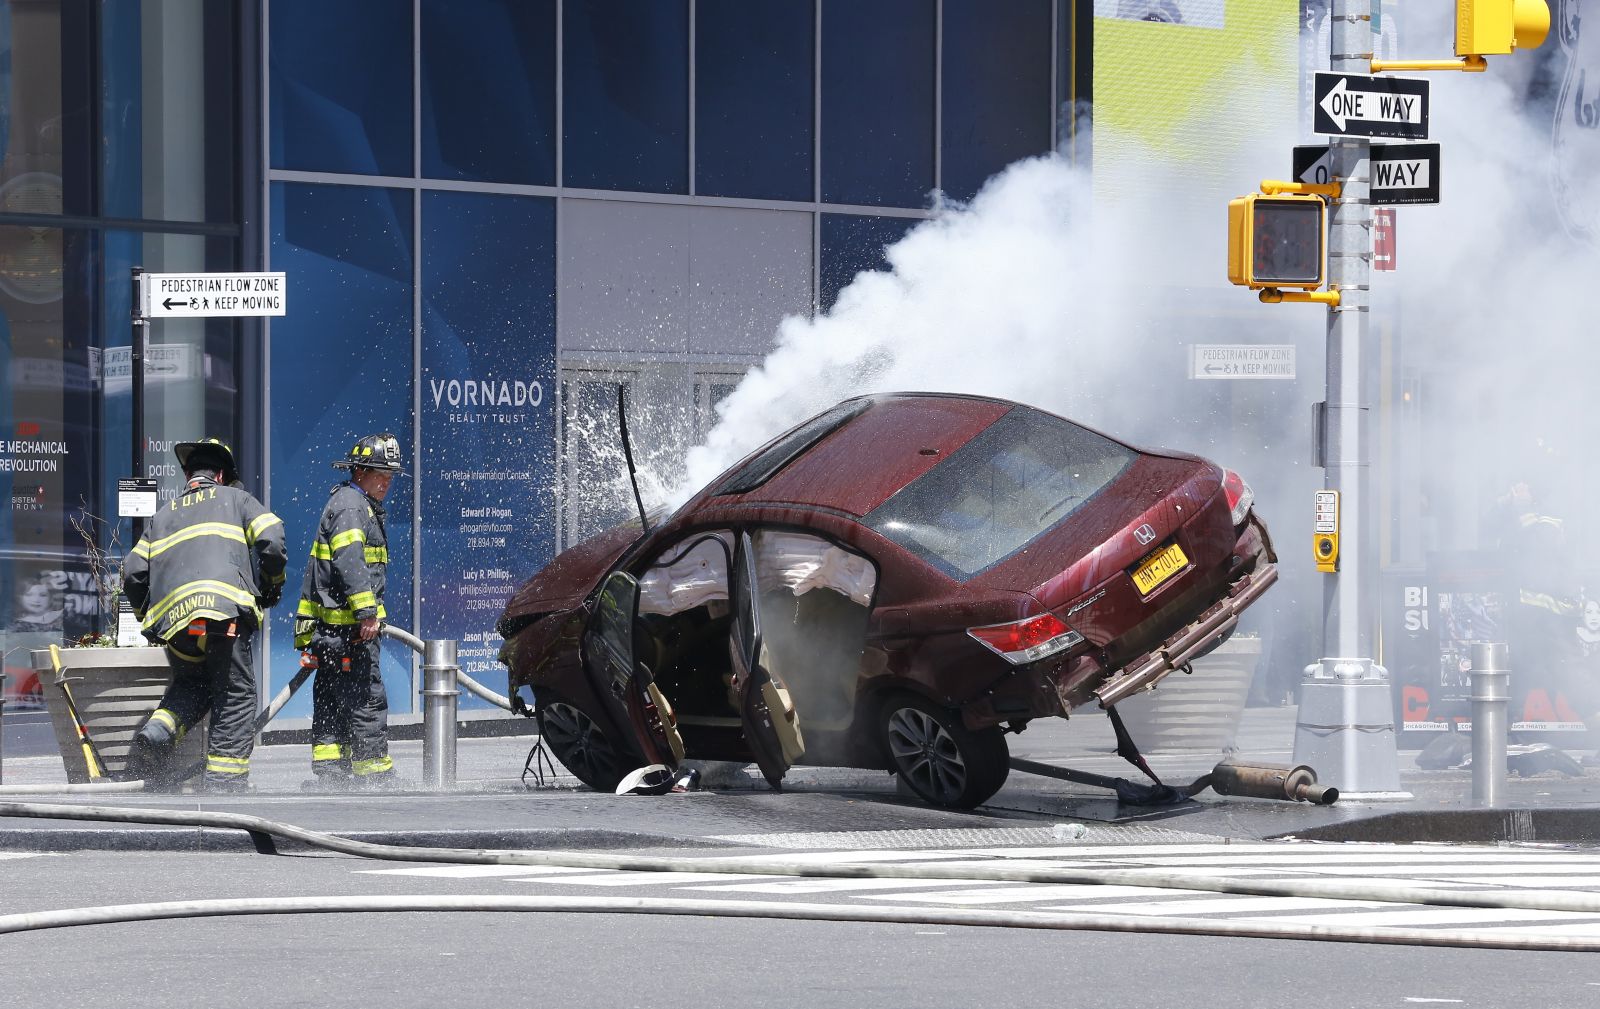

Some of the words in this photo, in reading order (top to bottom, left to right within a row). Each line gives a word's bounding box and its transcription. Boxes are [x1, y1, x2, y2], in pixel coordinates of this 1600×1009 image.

[1304, 6, 1315, 33] AT
[1331, 93, 1364, 118] ONE
[1380, 96, 1414, 121] WAY
[1376, 163, 1421, 186] WAY
[161, 279, 222, 292] PEDESTRIAN
[225, 279, 251, 292] FLOW
[254, 278, 280, 292] ZONE
[214, 297, 239, 310] KEEP
[242, 296, 280, 310] MOVING
[1202, 349, 1248, 360] PEDESTRIAN
[1250, 349, 1270, 360] FLOW
[1271, 349, 1291, 360] ZONE
[1242, 363, 1261, 374] KEEP
[1263, 363, 1291, 374] MOVING
[430, 379, 543, 409] VORNADO
[449, 413, 488, 423] REALTY
[492, 413, 526, 423] TRUST
[7, 441, 69, 454] MECHANICAL
[148, 436, 172, 452] hour
[0, 459, 57, 472] REVOLUTION
[148, 463, 176, 478] parts
[441, 470, 451, 480] For
[471, 470, 506, 481] Information
[461, 507, 485, 518] Edward
[1137, 564, 1157, 586] HNY
[1155, 547, 1182, 572] 7012
[463, 569, 478, 581] Lucy
[169, 595, 215, 624] BRANNON
[463, 632, 482, 642] Jason
